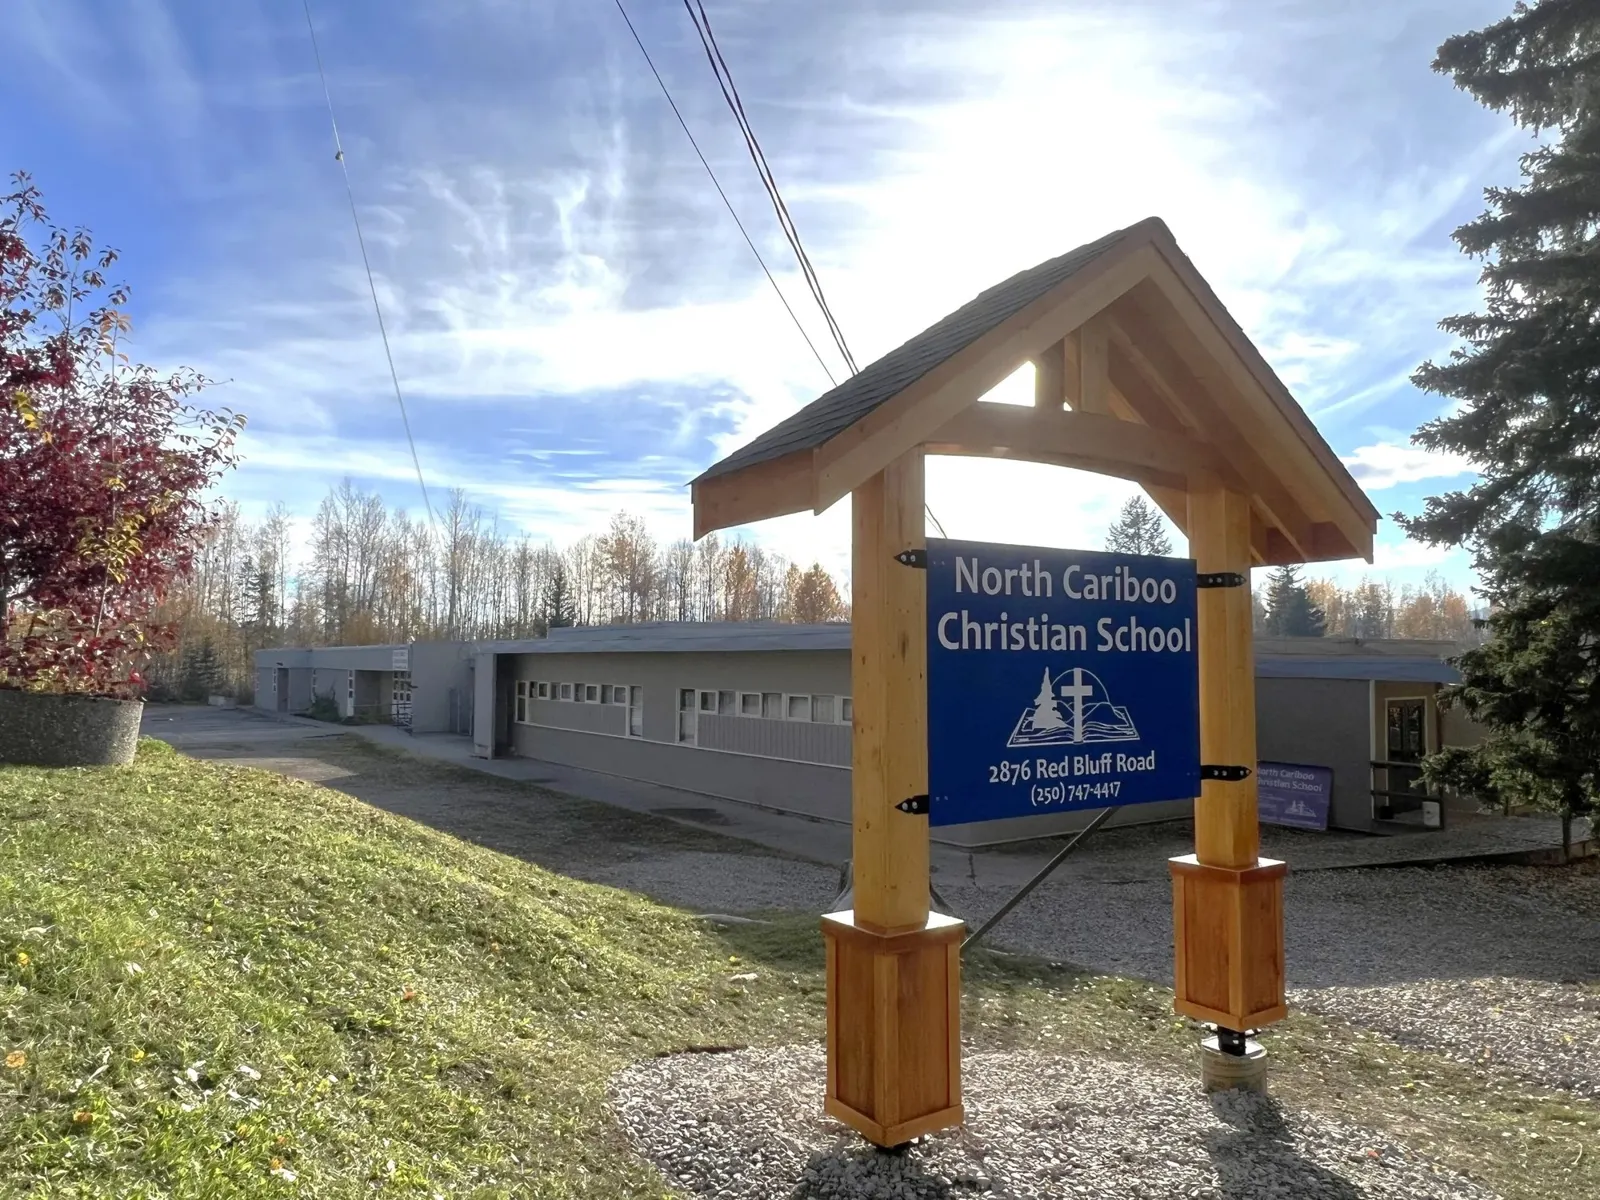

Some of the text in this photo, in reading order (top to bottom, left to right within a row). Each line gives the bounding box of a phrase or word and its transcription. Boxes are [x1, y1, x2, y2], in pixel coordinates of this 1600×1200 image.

[955, 556, 1177, 604] North Cariboo
[937, 610, 1192, 652] Christian School
[988, 750, 1156, 785] 2876 Red Bluff Road
[1257, 767, 1315, 781] orth Cariboo
[1031, 781, 1121, 806] (250) 747-4417
[1292, 781, 1323, 792] School
